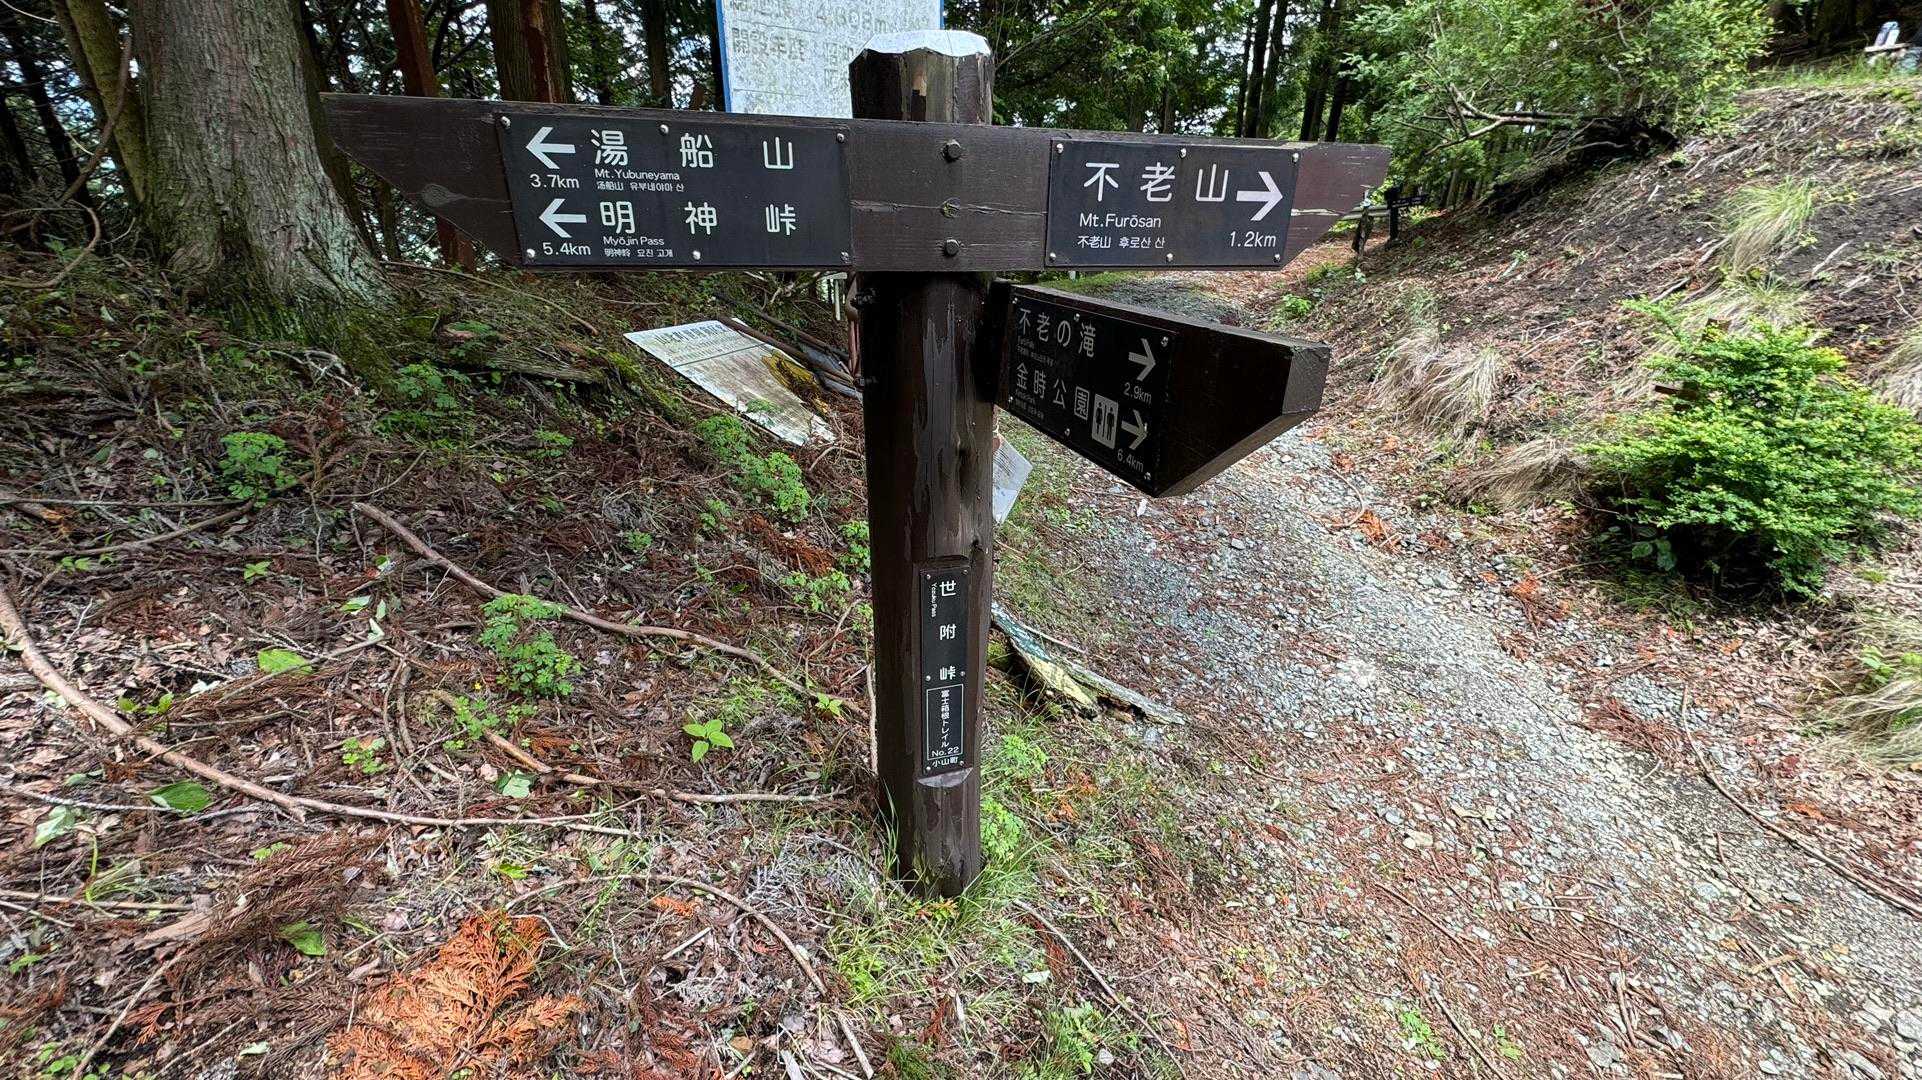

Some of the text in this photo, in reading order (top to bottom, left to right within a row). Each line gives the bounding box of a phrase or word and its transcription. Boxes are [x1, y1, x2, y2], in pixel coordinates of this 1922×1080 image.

[590, 129, 794, 170] 湯船山
[529, 174, 580, 189] 3.7km
[594, 168, 680, 181] Mt.Yubuneyama
[1083, 162, 1229, 202] 不老山
[599, 200, 796, 235] 明神峠
[1079, 213, 1162, 228] Mt.Furōsan
[640, 236, 665, 246] Pass
[1077, 235, 1111, 249] 不老山
[1155, 236, 1166, 249] 산
[1230, 231, 1277, 248] 1.2km
[542, 242, 591, 257] 5.4km
[1018, 307, 1097, 358] 不老の滝
[1016, 362, 1089, 421] 金時公園
[1124, 382, 1151, 402] 2.9km
[1117, 449, 1144, 473] 6.4km
[939, 580, 957, 681] 世附峠
